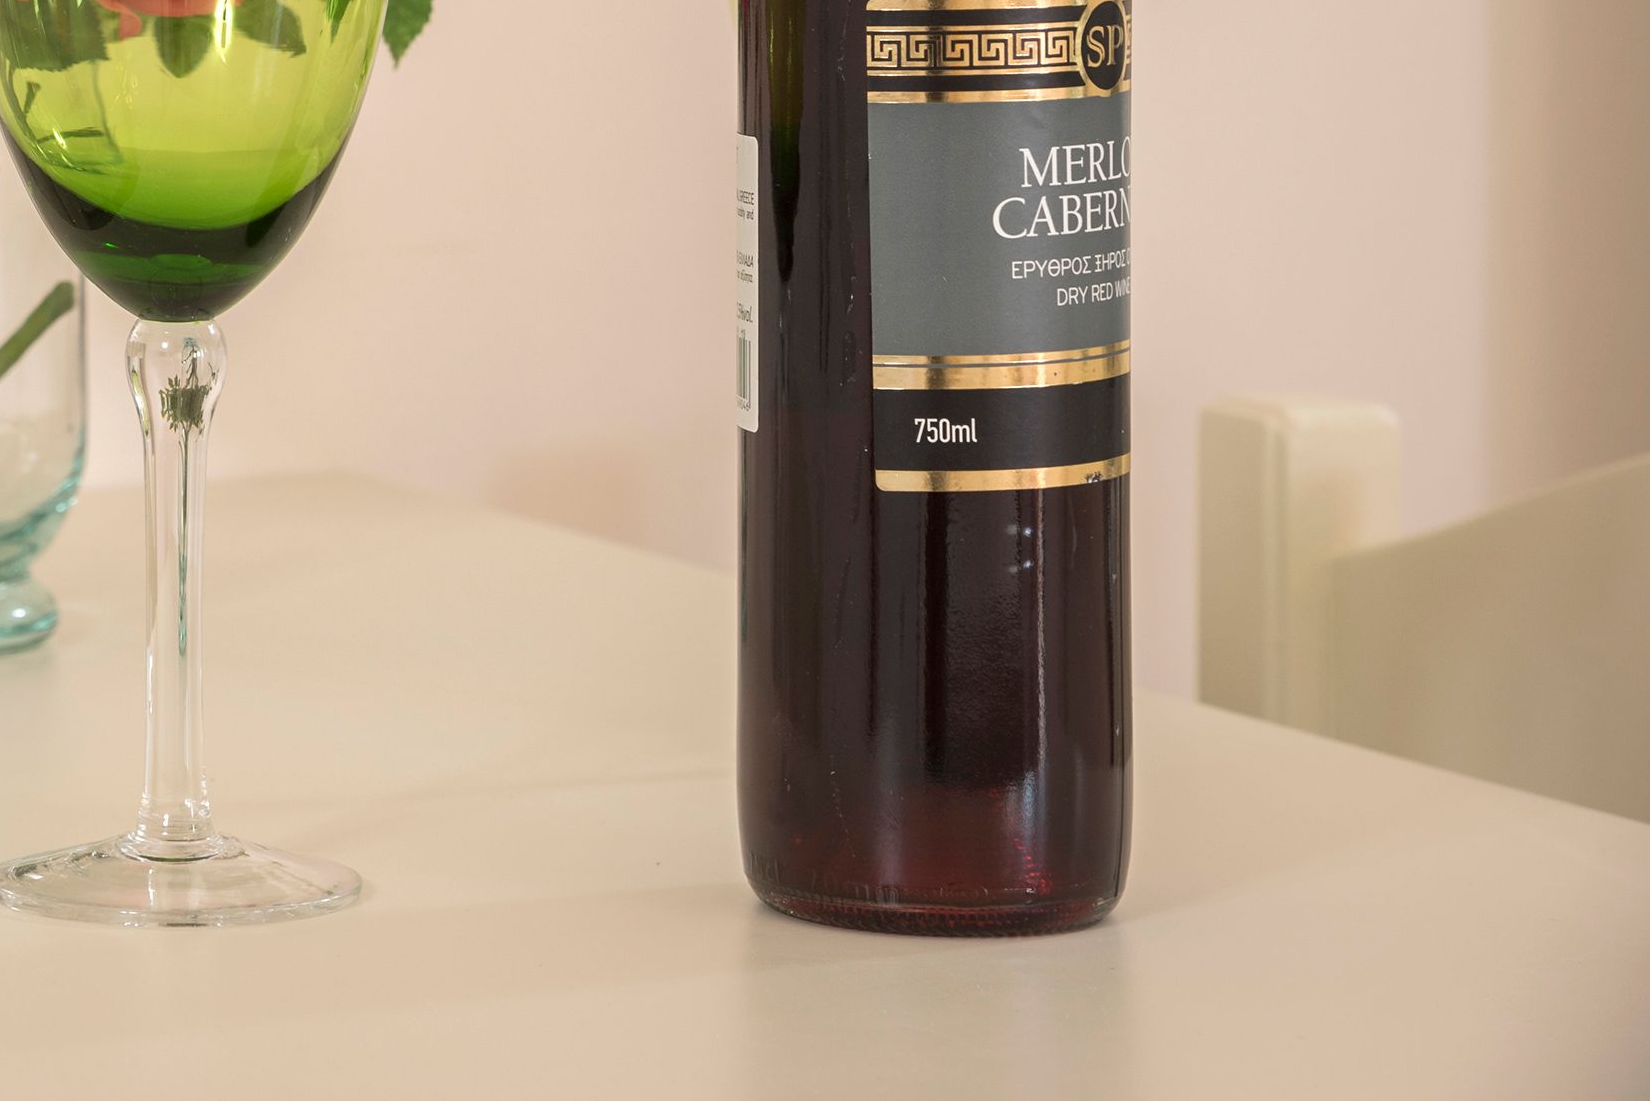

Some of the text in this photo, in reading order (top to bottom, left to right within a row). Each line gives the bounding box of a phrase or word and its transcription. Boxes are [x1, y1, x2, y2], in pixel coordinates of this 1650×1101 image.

[1086, 24, 1124, 68] SP
[1011, 256, 1092, 279] ΕΡΥΘΡΟΣ
[1056, 285, 1089, 306] DRY
[1091, 282, 1114, 303] RED
[914, 417, 978, 443] 750ml
